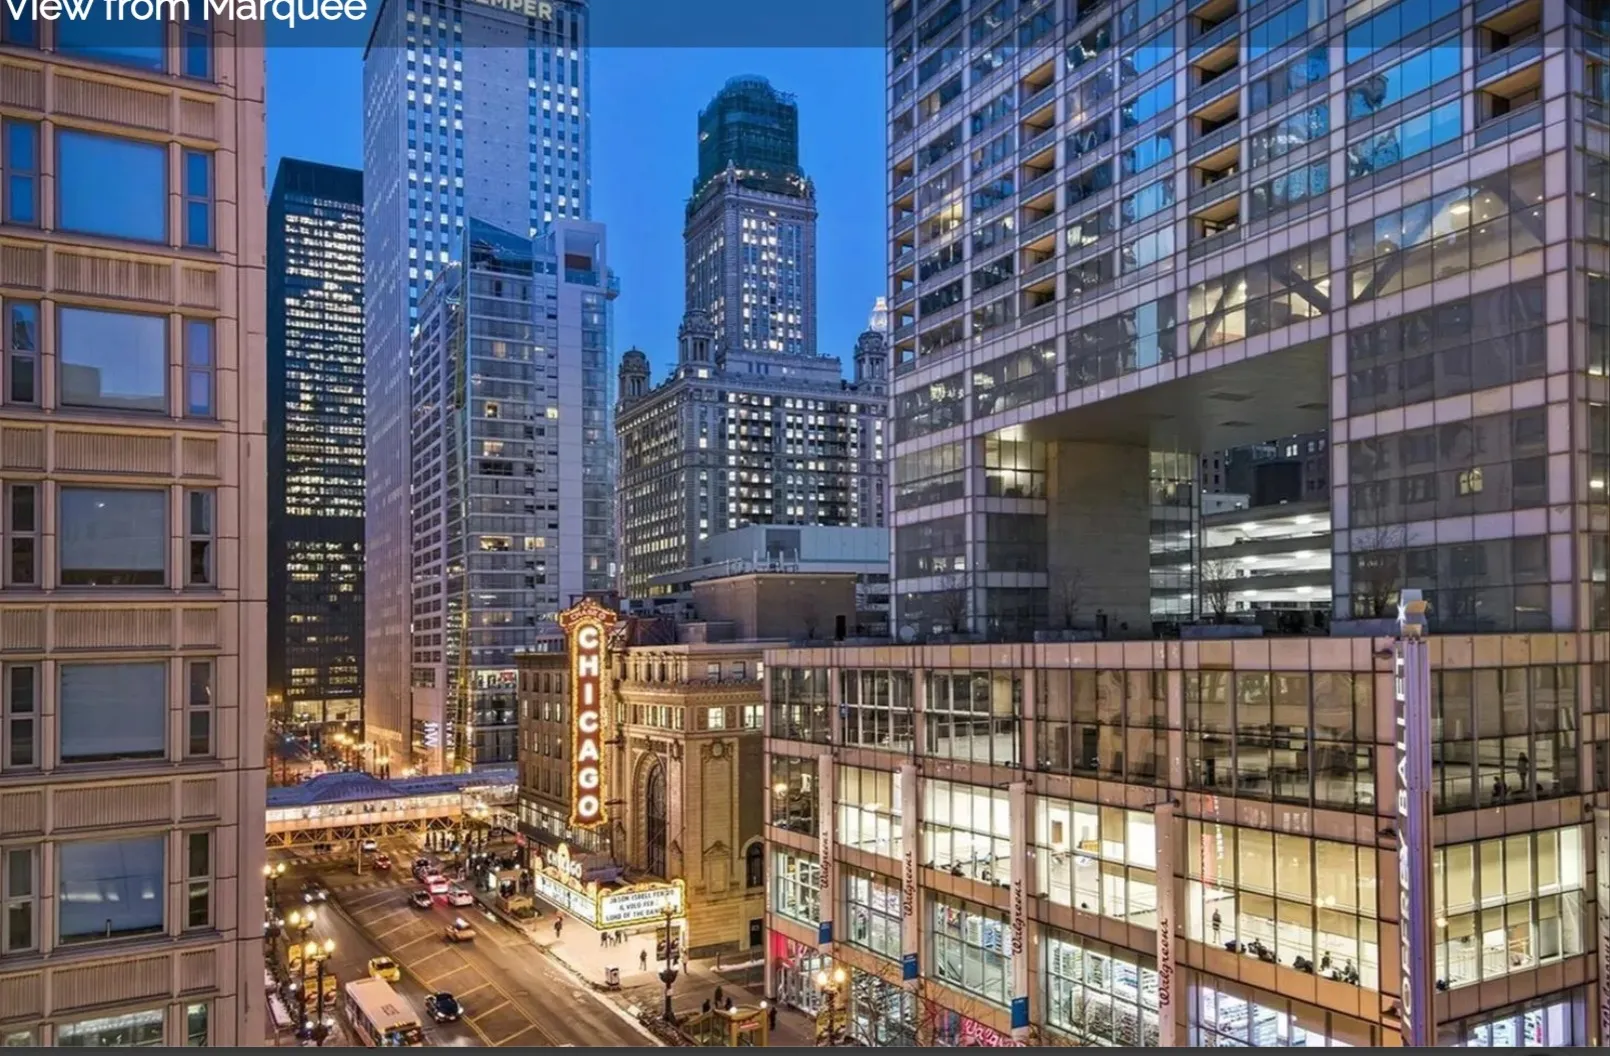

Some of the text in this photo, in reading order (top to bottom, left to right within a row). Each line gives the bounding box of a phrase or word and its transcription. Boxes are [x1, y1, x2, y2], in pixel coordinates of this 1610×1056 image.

[578, 625, 599, 818] CHICAGO
[1396, 648, 1408, 817] BALLET
[820, 831, 831, 890] Walgreens
[903, 851, 916, 917] Walgreens
[1012, 878, 1026, 956] Walgreens
[1159, 918, 1174, 1008] Walgreens
